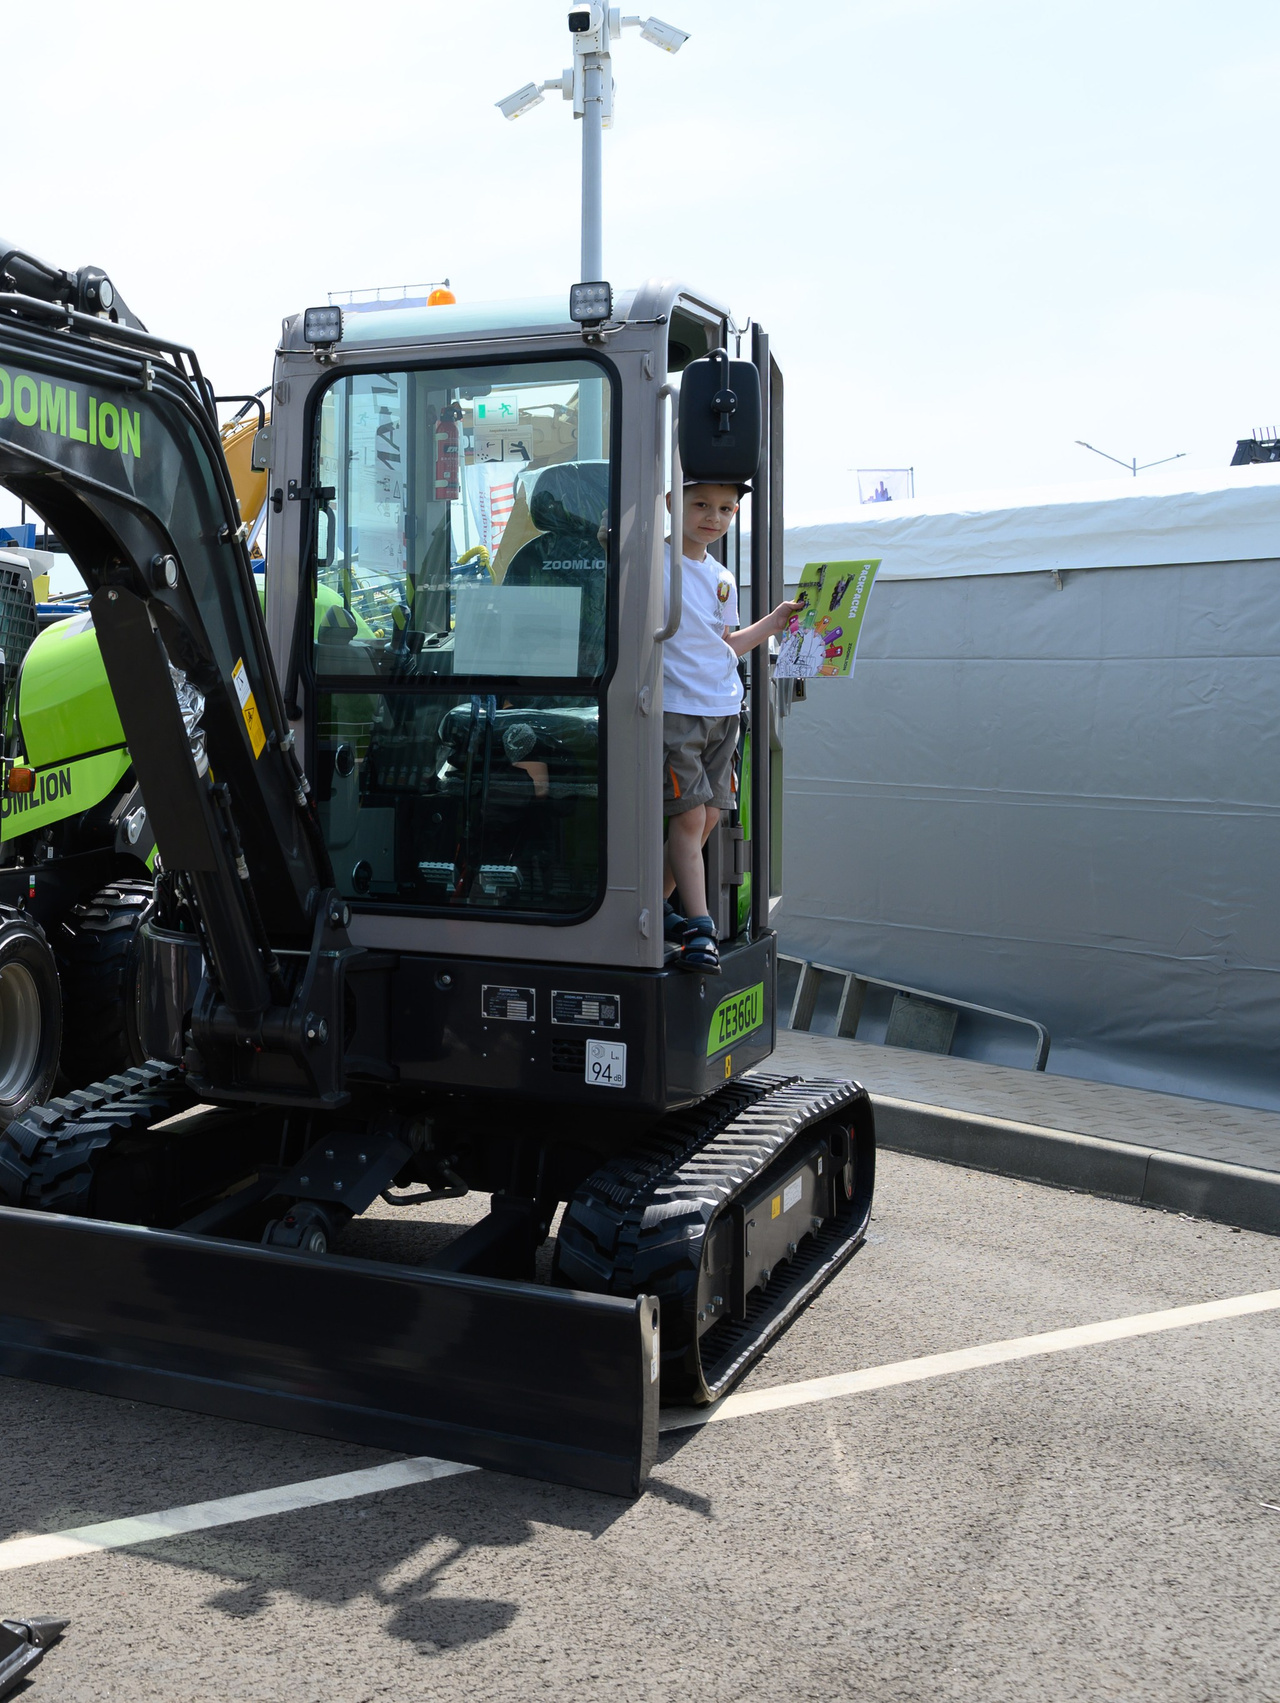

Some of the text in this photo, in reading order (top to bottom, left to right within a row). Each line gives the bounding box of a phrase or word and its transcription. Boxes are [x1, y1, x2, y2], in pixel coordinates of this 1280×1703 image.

[848, 564, 871, 619] РАСКРАСКА
[718, 991, 758, 1044] ZE36GU
[592, 1061, 622, 1083] 94 dB
